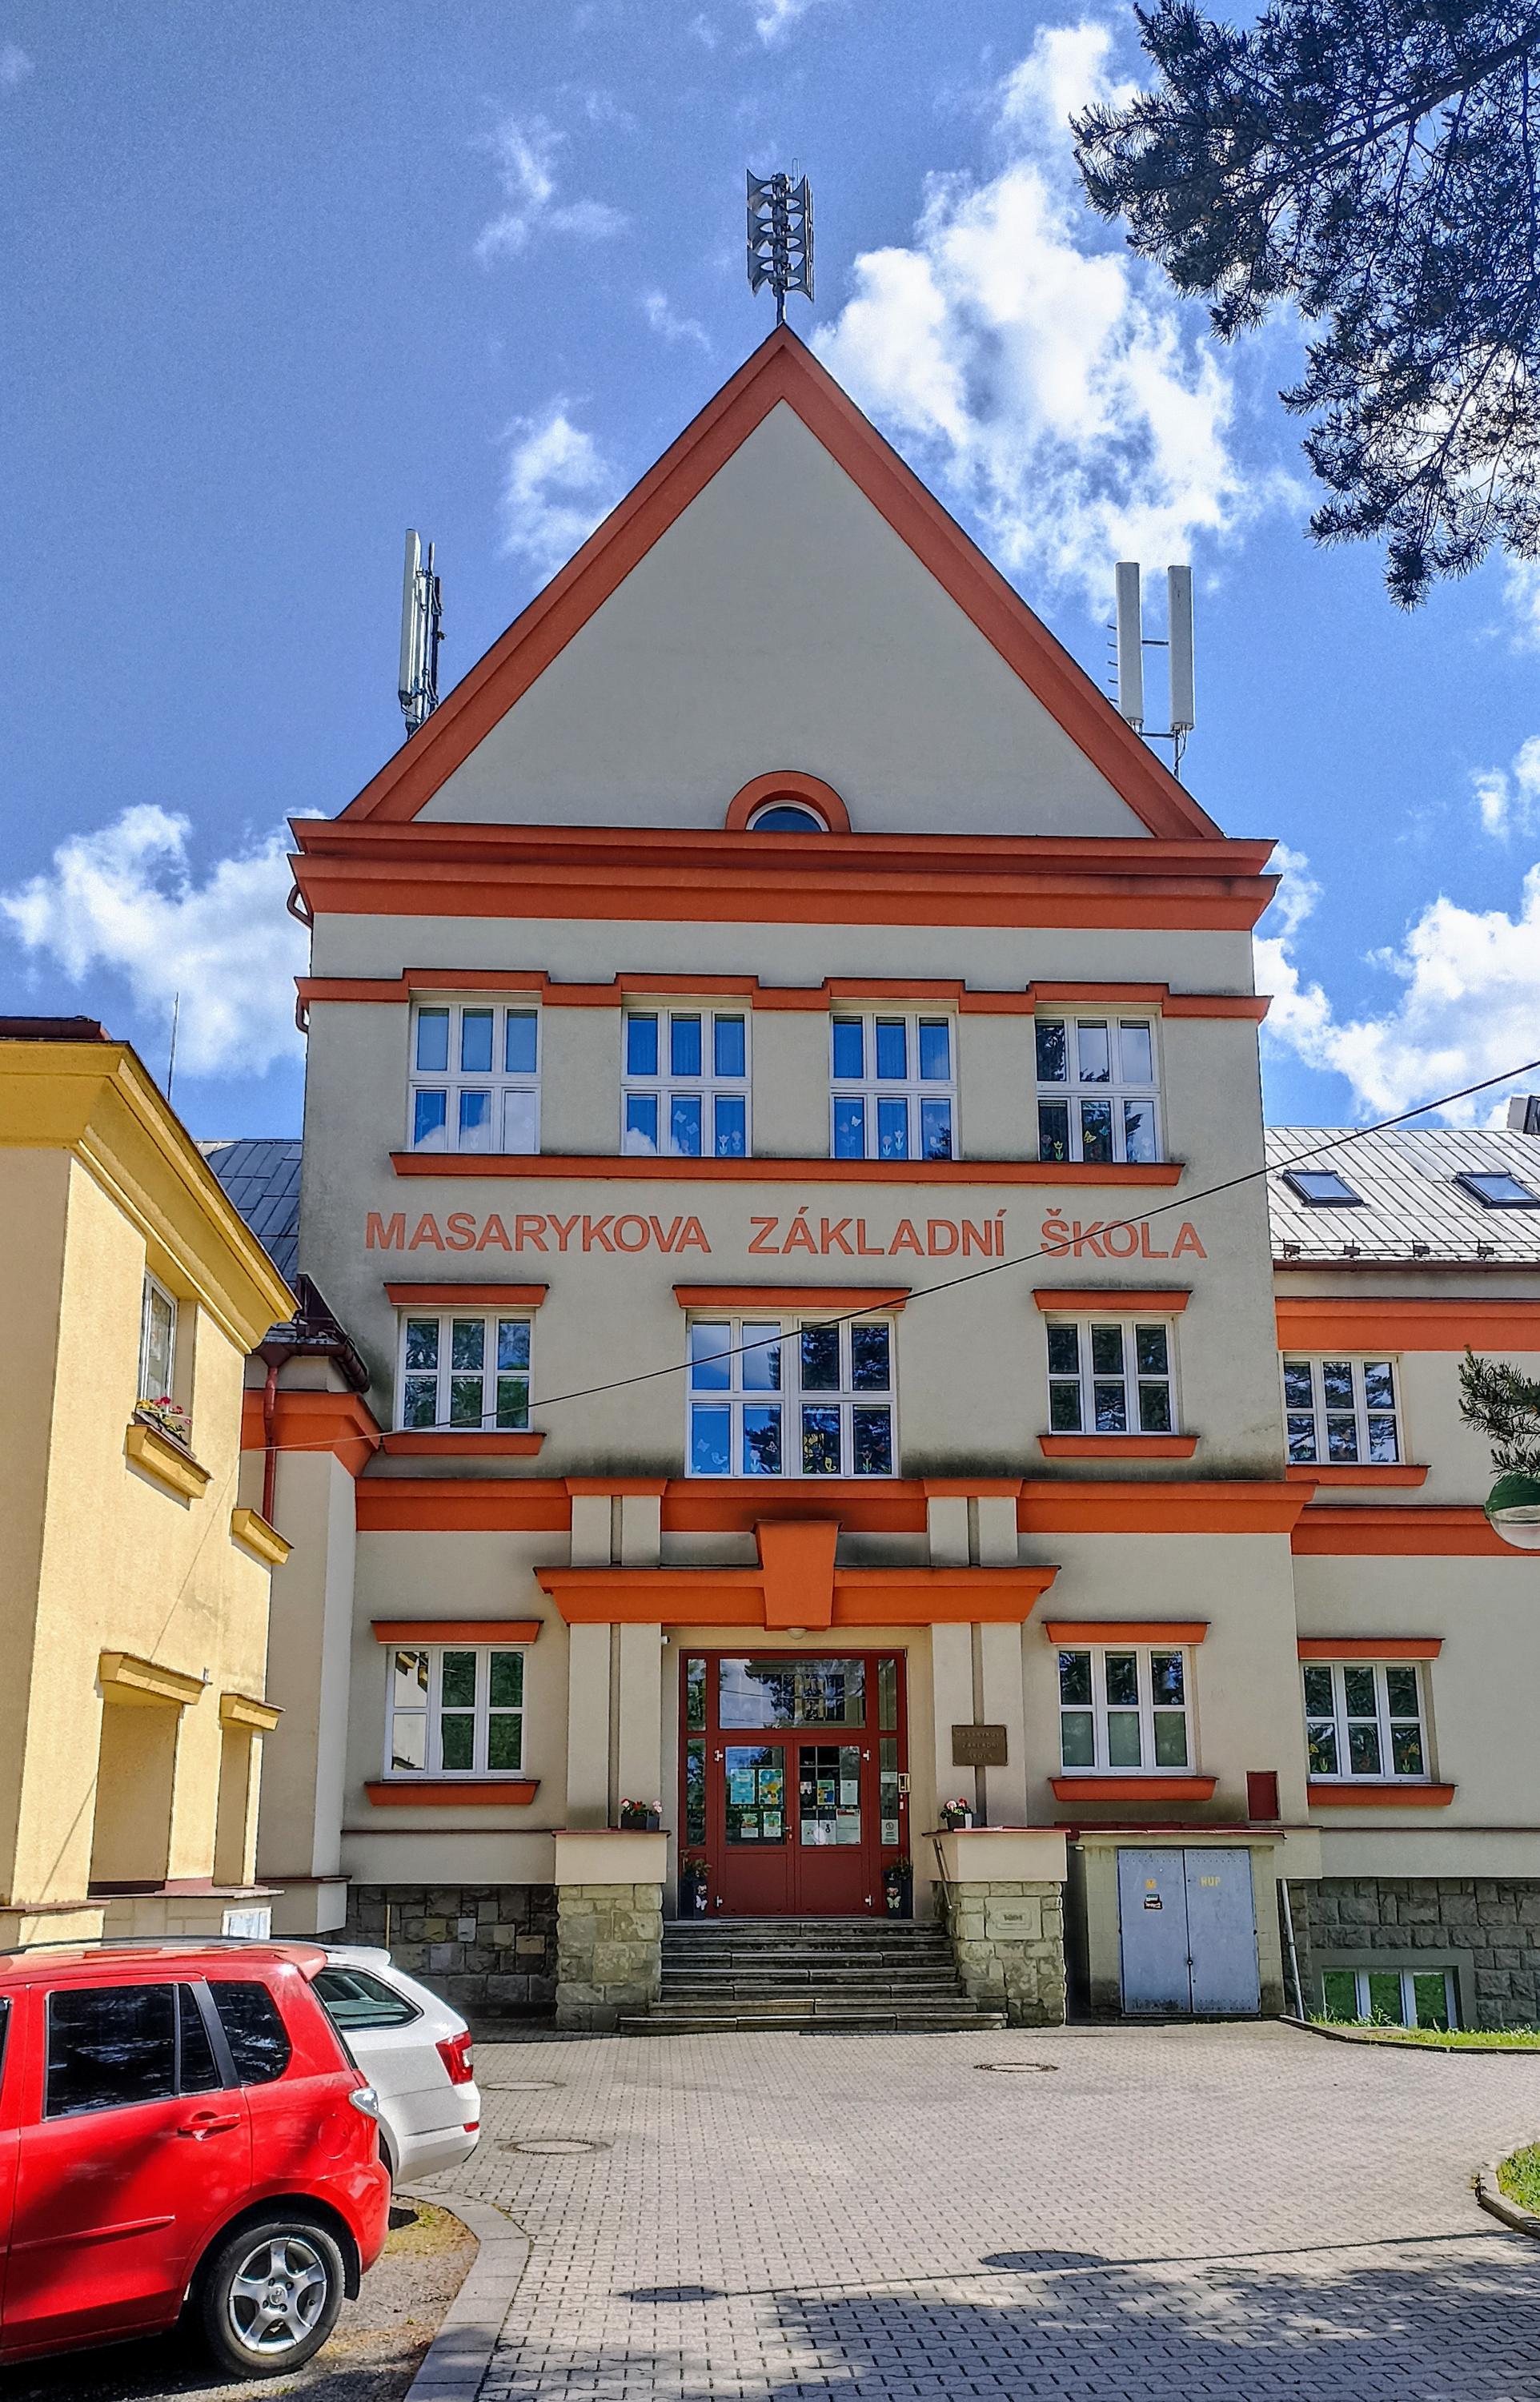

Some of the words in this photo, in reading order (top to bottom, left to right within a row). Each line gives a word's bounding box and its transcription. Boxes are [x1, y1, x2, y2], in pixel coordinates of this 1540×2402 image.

[366, 1212, 712, 1254] MASARYKOVA
[748, 1207, 1008, 1257] ZÁKLADNÍ
[1041, 1208, 1207, 1259] ŠKOLA
[1201, 1876, 1221, 1886] HUP
